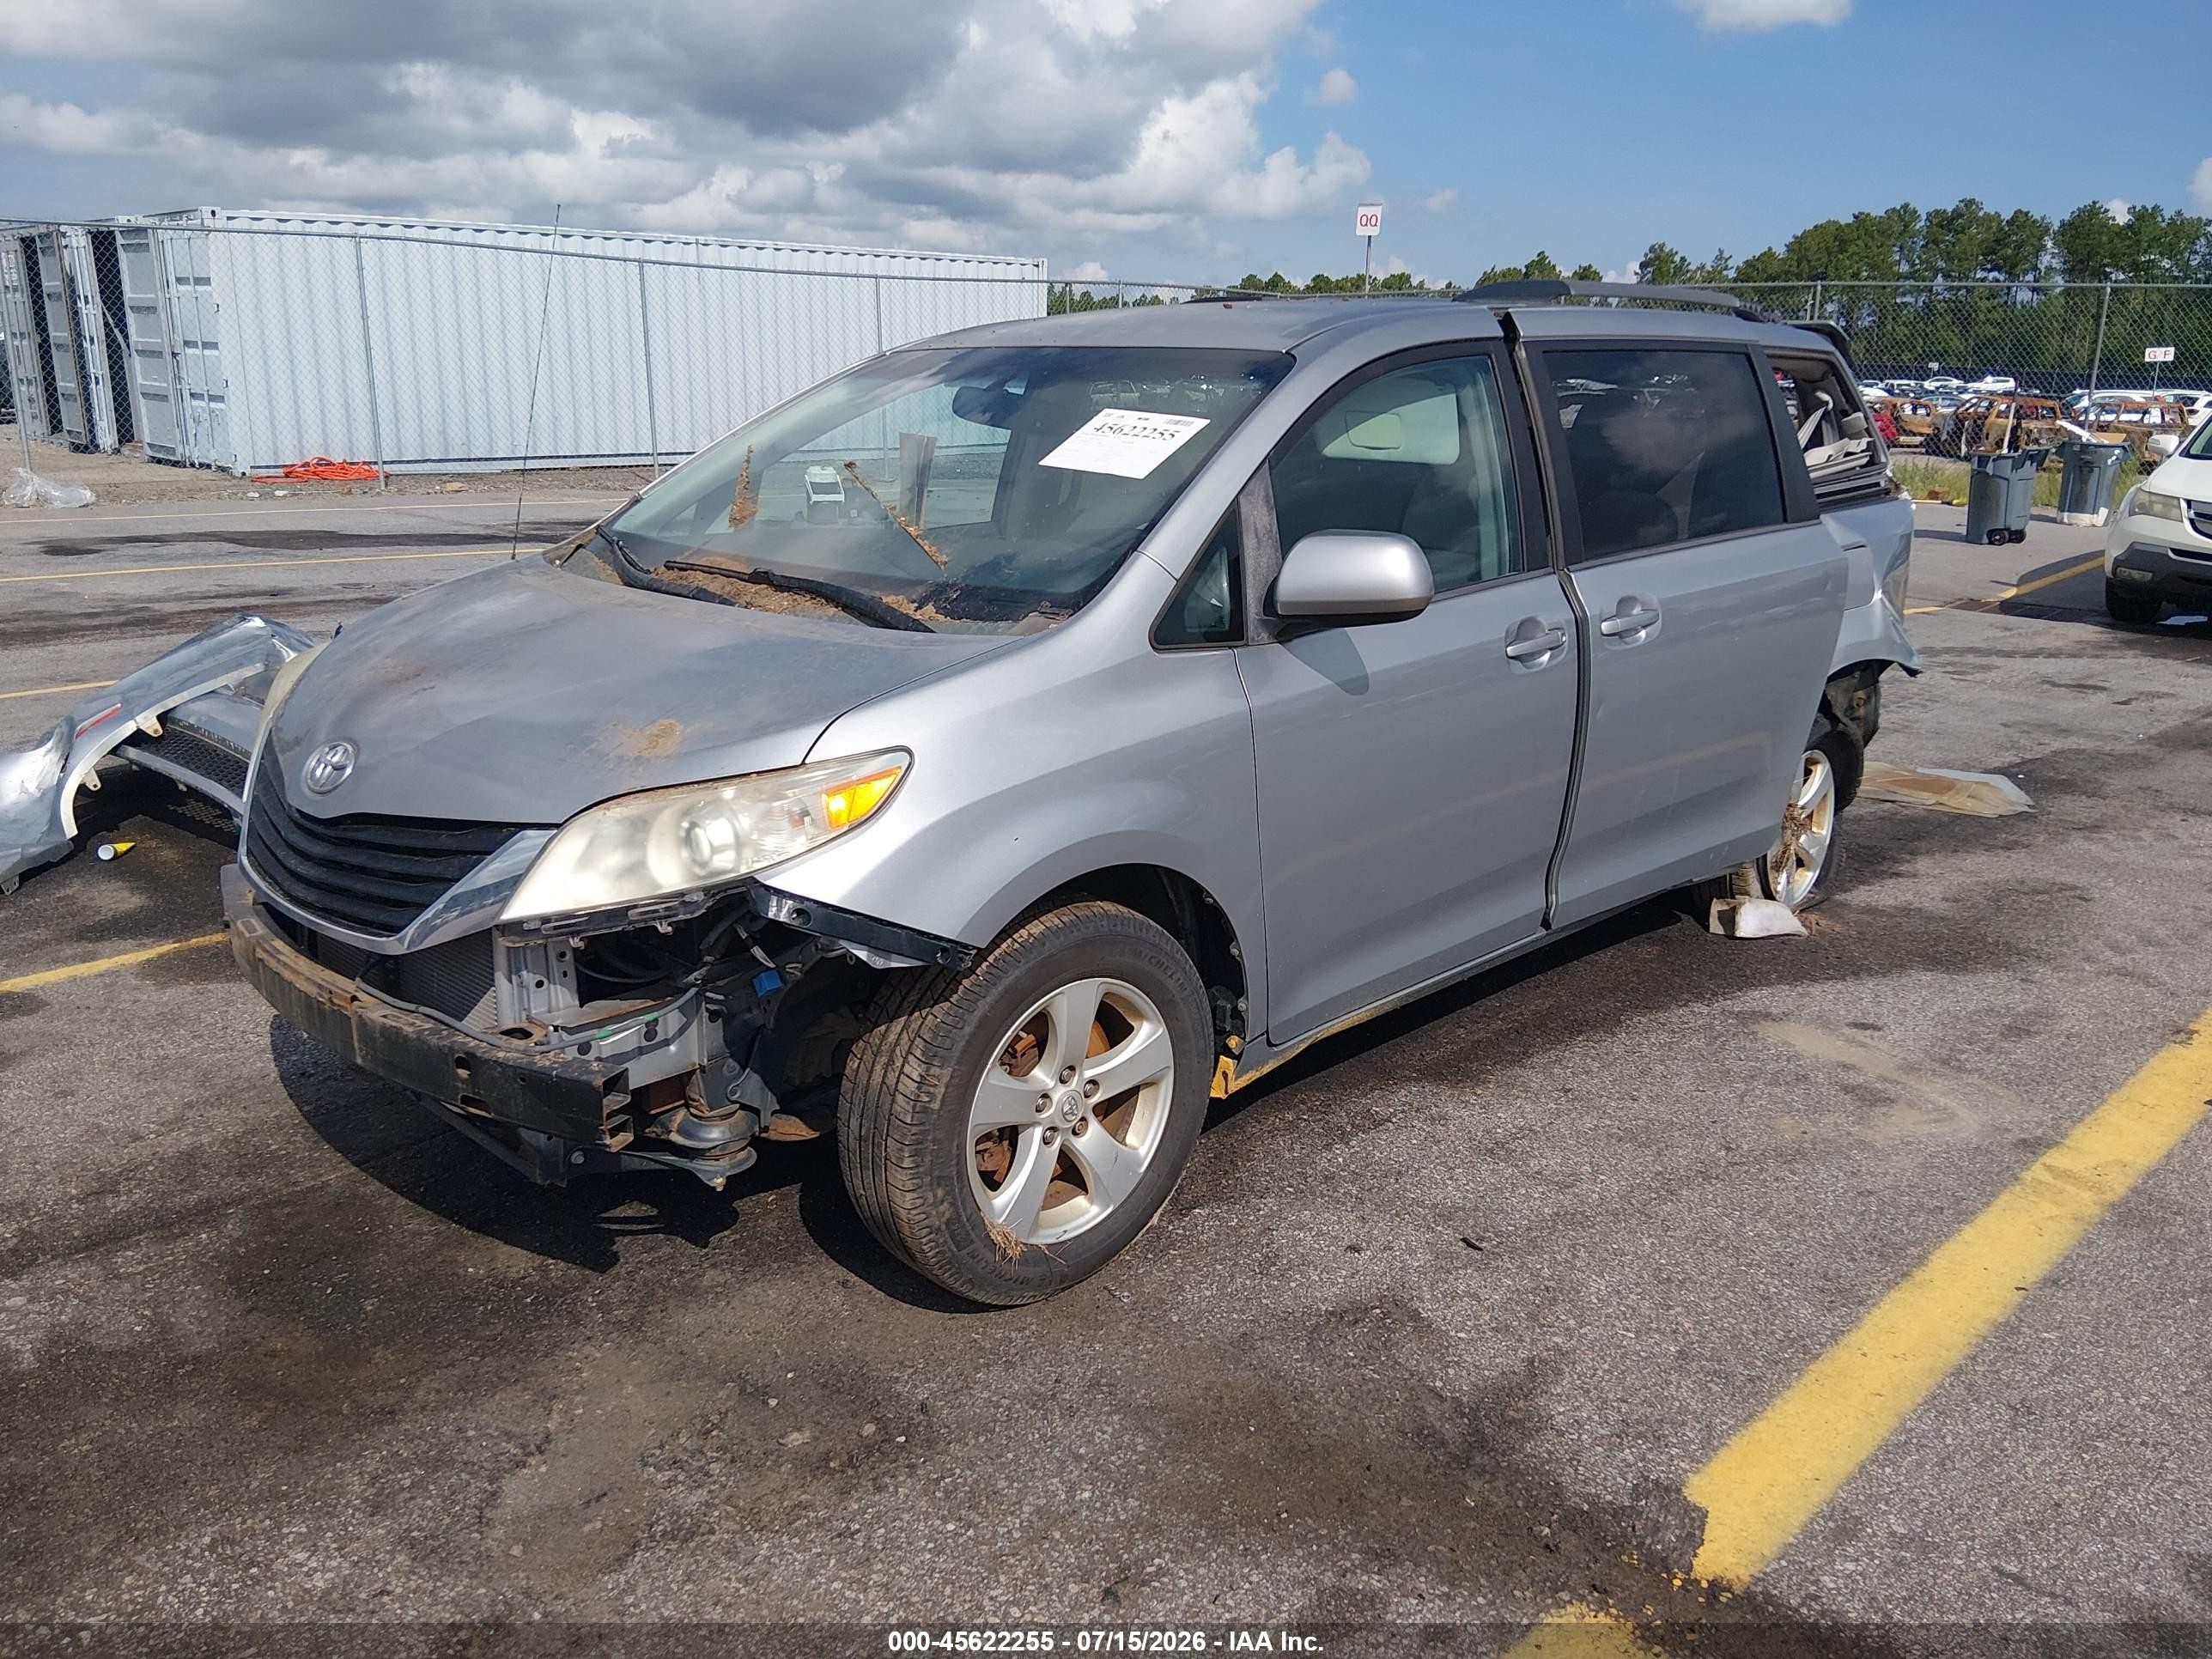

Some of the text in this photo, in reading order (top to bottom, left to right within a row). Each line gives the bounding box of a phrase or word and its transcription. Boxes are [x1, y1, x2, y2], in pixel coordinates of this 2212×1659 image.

[1359, 214, 1378, 227] QQ
[2148, 350, 2157, 359] G
[1094, 422, 1182, 441] 45622255
